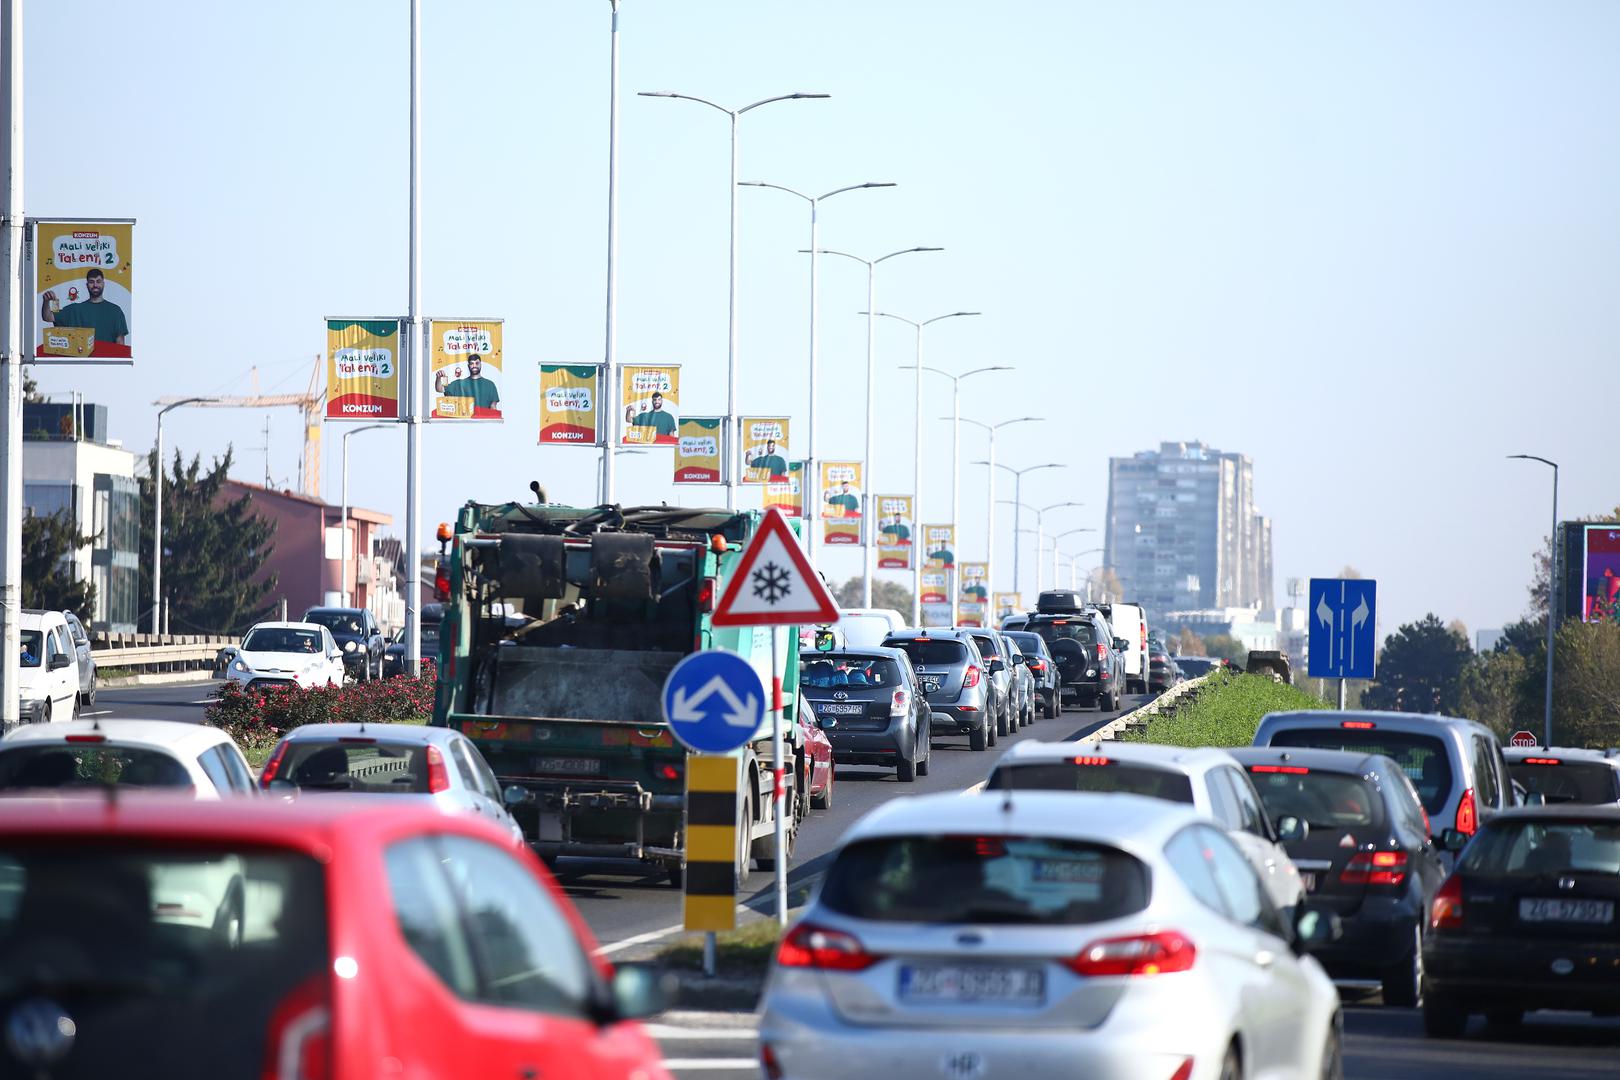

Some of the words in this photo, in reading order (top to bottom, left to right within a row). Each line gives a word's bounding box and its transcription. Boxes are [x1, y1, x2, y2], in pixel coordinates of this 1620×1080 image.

[105, 252, 114, 264] 2
[482, 342, 489, 351] 2
[381, 363, 390, 374] 2
[662, 382, 669, 390] 2
[342, 403, 383, 413] KONZUM
[582, 399, 590, 408] 2
[551, 431, 584, 440] KONZUM
[708, 446, 715, 454] 2
[823, 704, 831, 713] ZG
[1512, 738, 1535, 747] STOP
